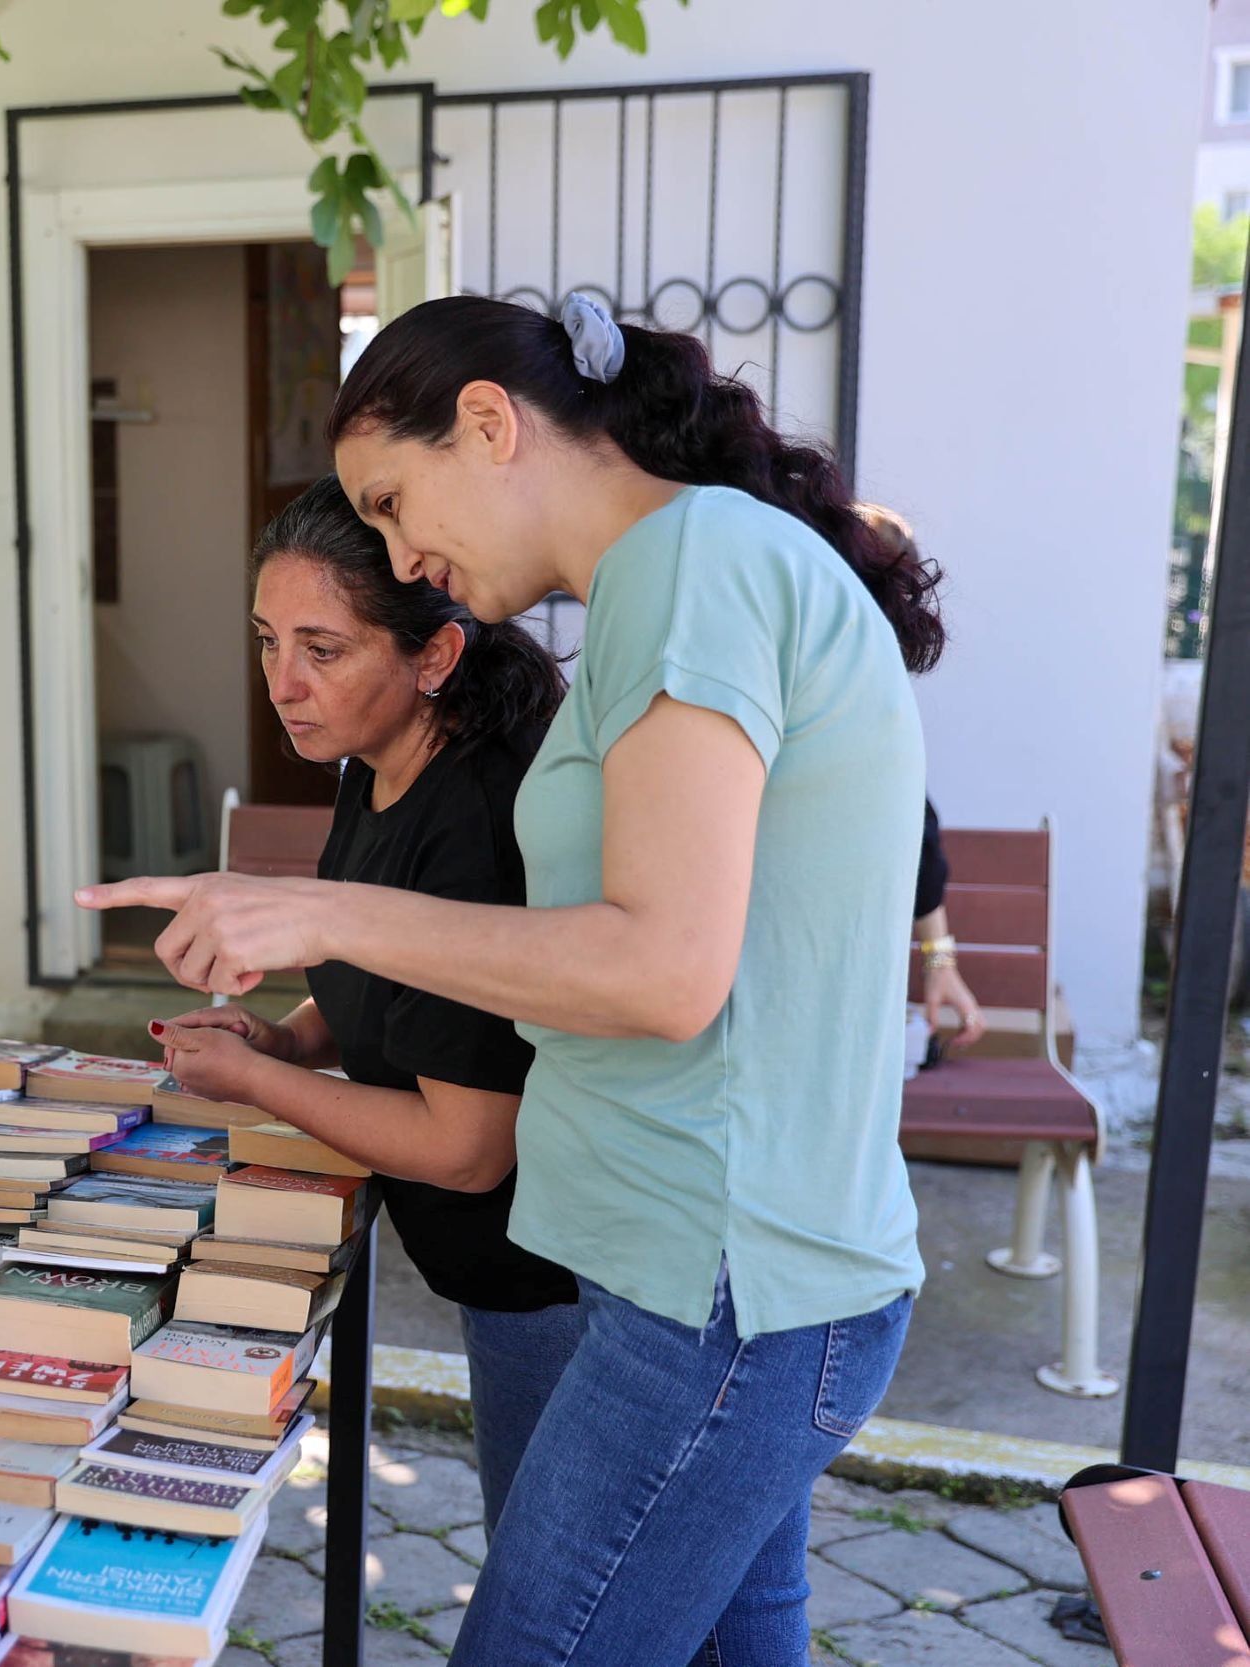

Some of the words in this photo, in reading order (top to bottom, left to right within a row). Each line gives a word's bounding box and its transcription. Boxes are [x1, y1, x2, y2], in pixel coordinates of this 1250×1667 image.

[112, 1148, 223, 1162] NLP
[4, 1267, 148, 1293] BROWN
[29, 1278, 104, 1293] DAN
[160, 1336, 191, 1347] Kar
[166, 1333, 228, 1347] Kokusu
